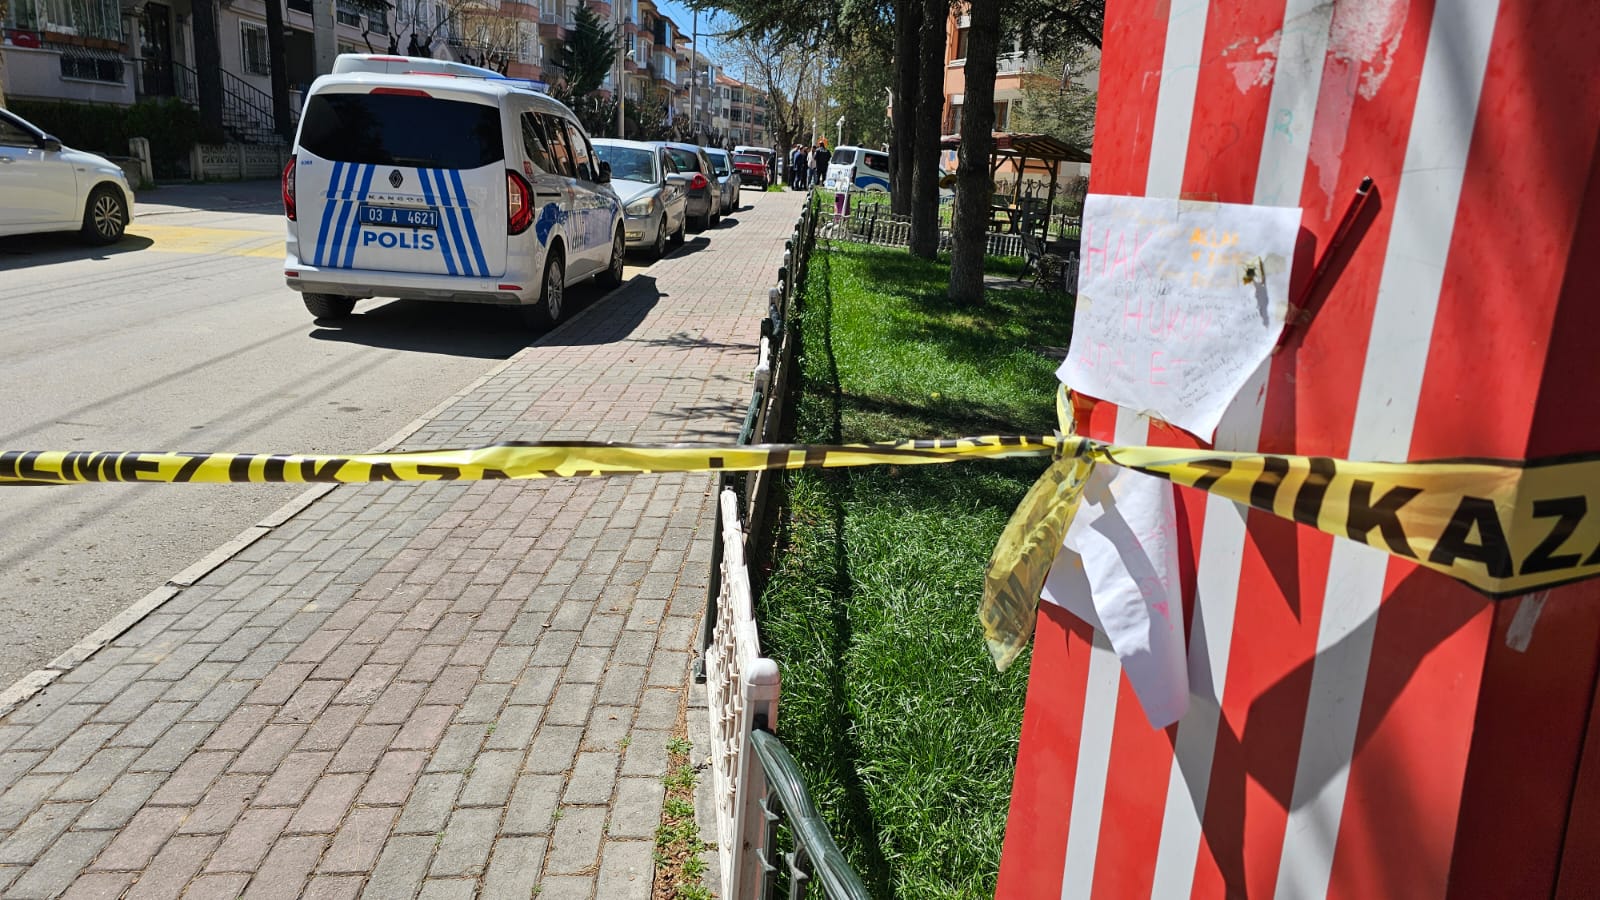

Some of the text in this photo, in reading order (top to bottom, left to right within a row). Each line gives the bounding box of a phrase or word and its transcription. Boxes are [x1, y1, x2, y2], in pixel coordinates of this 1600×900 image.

[368, 194, 424, 203] KANGOO
[368, 208, 435, 225] 03 A 4621
[363, 226, 435, 250] POLİS
[1085, 223, 1153, 282] HAK
[1346, 480, 1600, 579] KAZ
